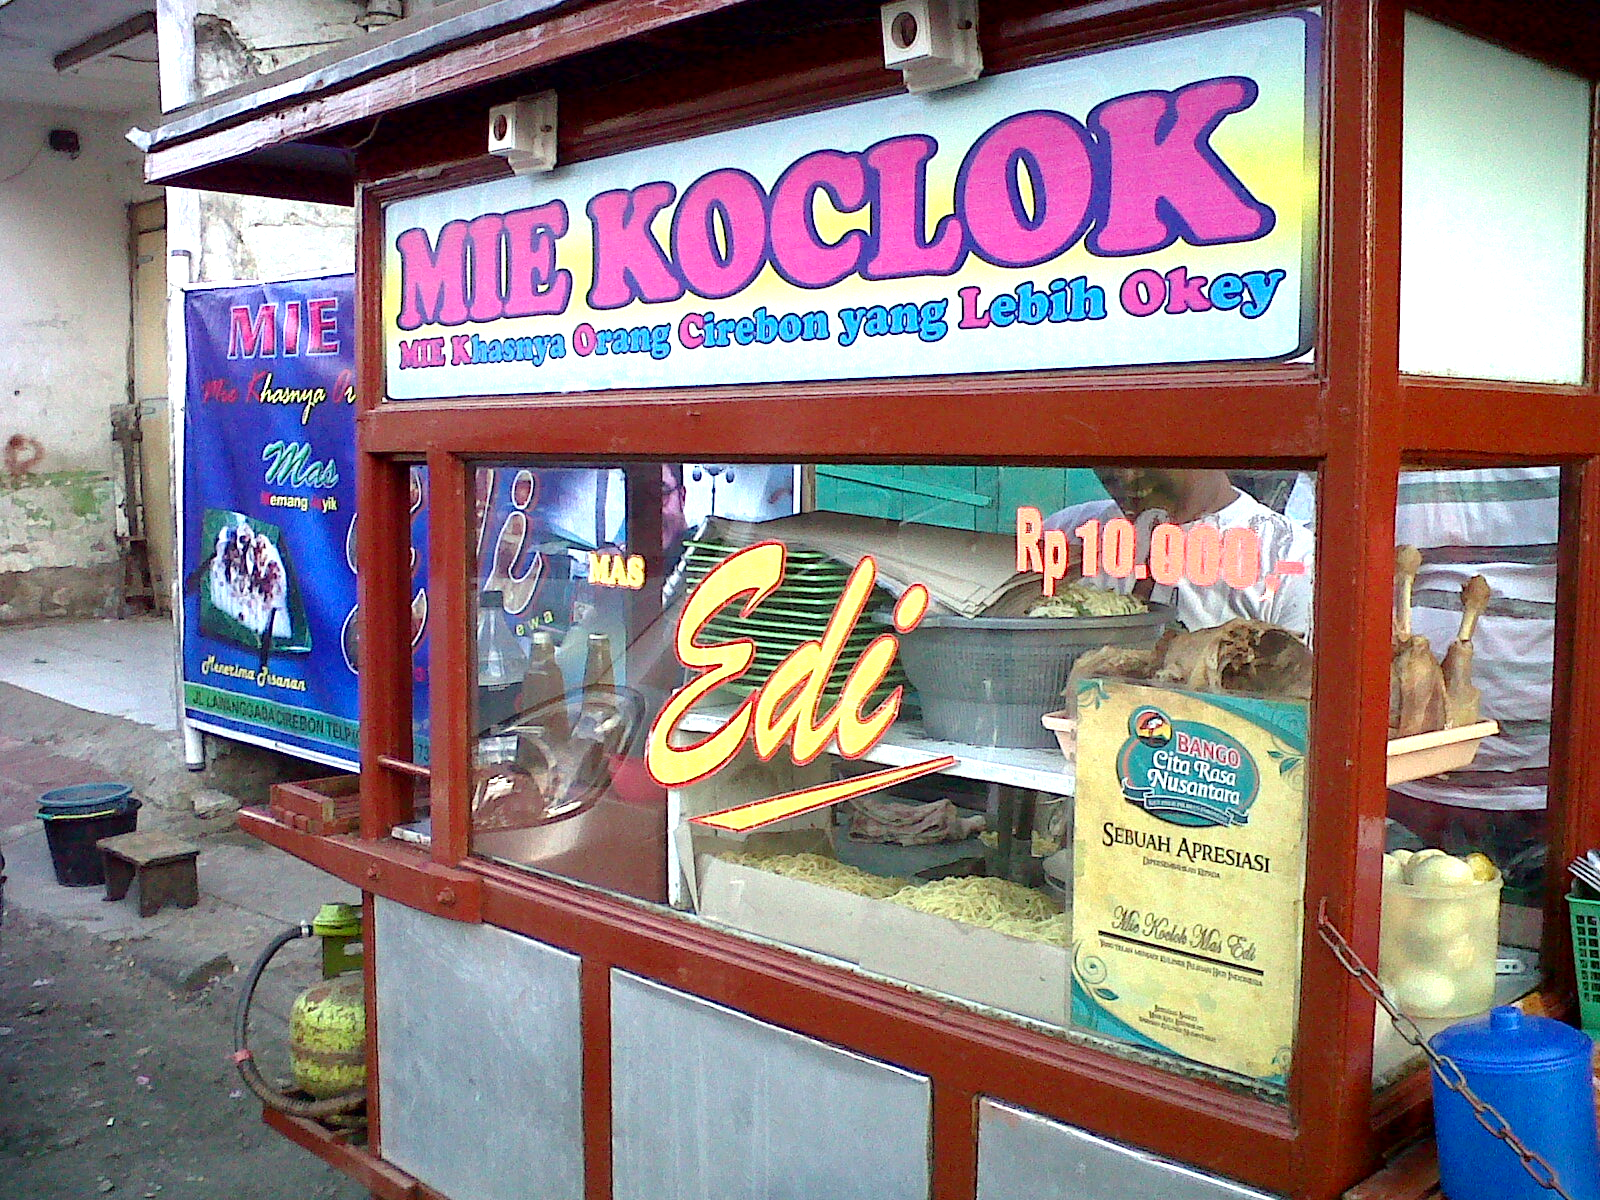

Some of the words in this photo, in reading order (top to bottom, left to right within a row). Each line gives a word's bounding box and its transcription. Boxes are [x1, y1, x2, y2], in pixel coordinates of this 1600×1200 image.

[396, 200, 572, 330] MIE
[586, 76, 1276, 309] KOCLOK
[227, 297, 340, 360] MIE
[399, 337, 446, 370] MIE
[451, 332, 566, 366] Khasnya
[573, 322, 671, 360] Orang
[678, 306, 830, 349] Cirebon
[838, 298, 948, 346] yang
[958, 275, 1107, 330] Lebih
[1119, 266, 1287, 319] Okey
[247, 370, 326, 425] Khasnya
[262, 440, 339, 488] Mas
[587, 551, 647, 590] MAS
[1016, 506, 1068, 597] Rp
[644, 540, 930, 788] Edi
[1152, 750, 1190, 775] Cita
[1194, 759, 1236, 786] Rasa
[1176, 732, 1241, 768] BANGO
[1147, 769, 1241, 806] Nusantara
